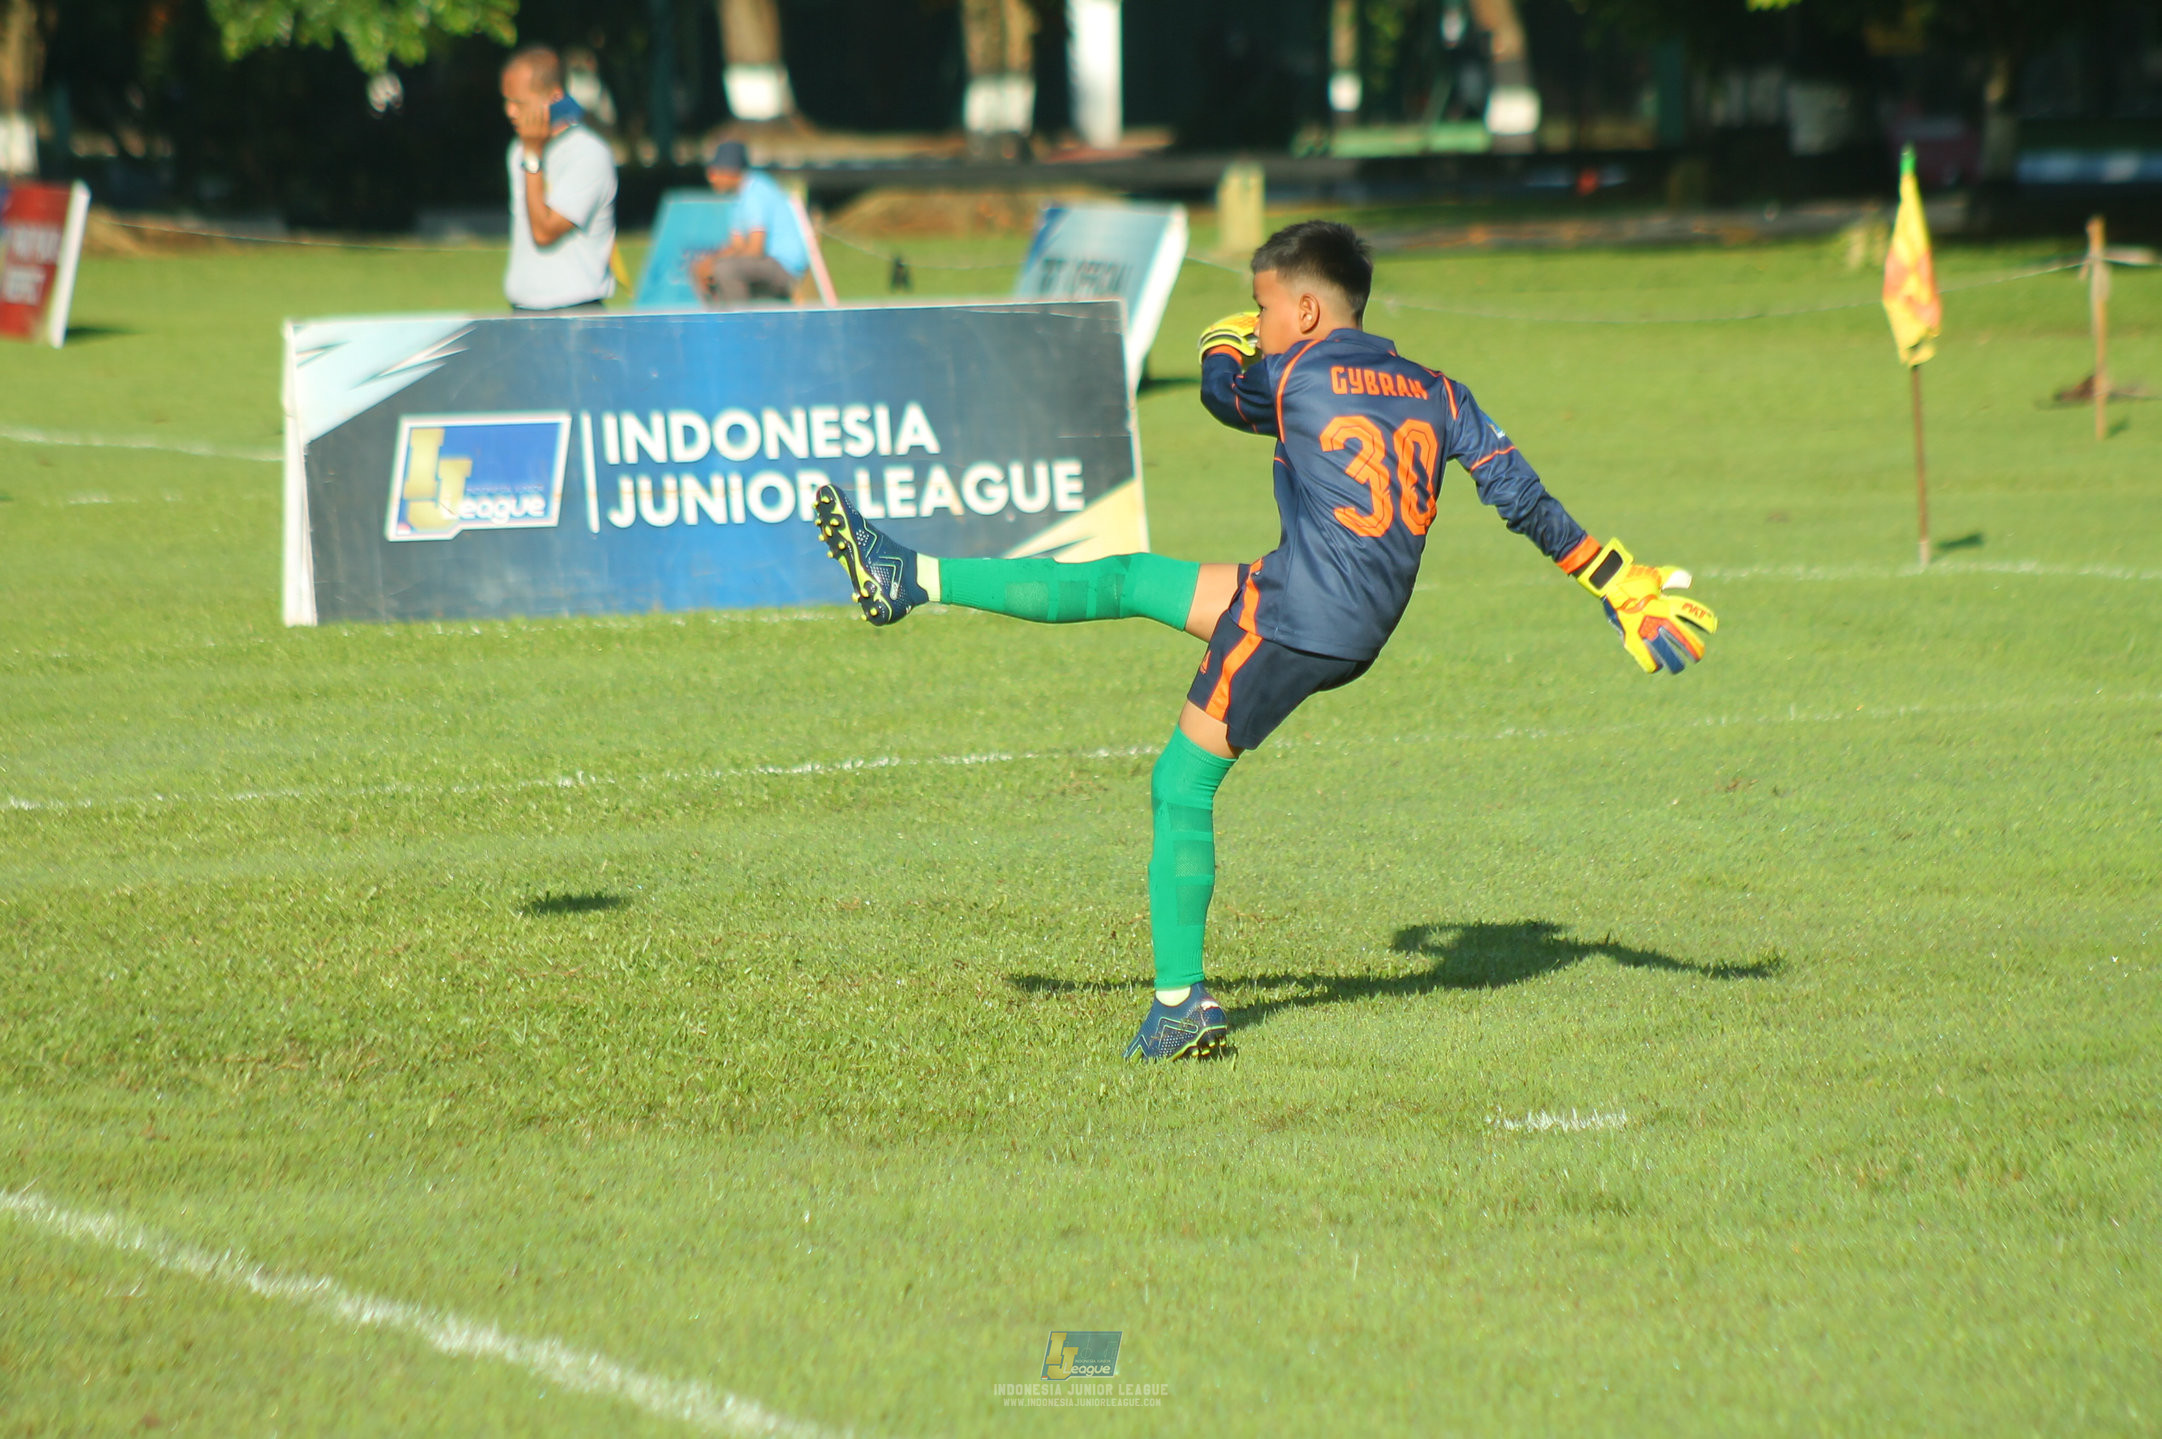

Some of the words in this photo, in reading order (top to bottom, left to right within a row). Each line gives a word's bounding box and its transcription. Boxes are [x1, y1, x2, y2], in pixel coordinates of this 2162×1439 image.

[602, 402, 942, 465] INDONESIA
[607, 470, 832, 529] JUNIOR
[854, 459, 1086, 520] LEAGUE
[1319, 414, 1438, 538] 30
